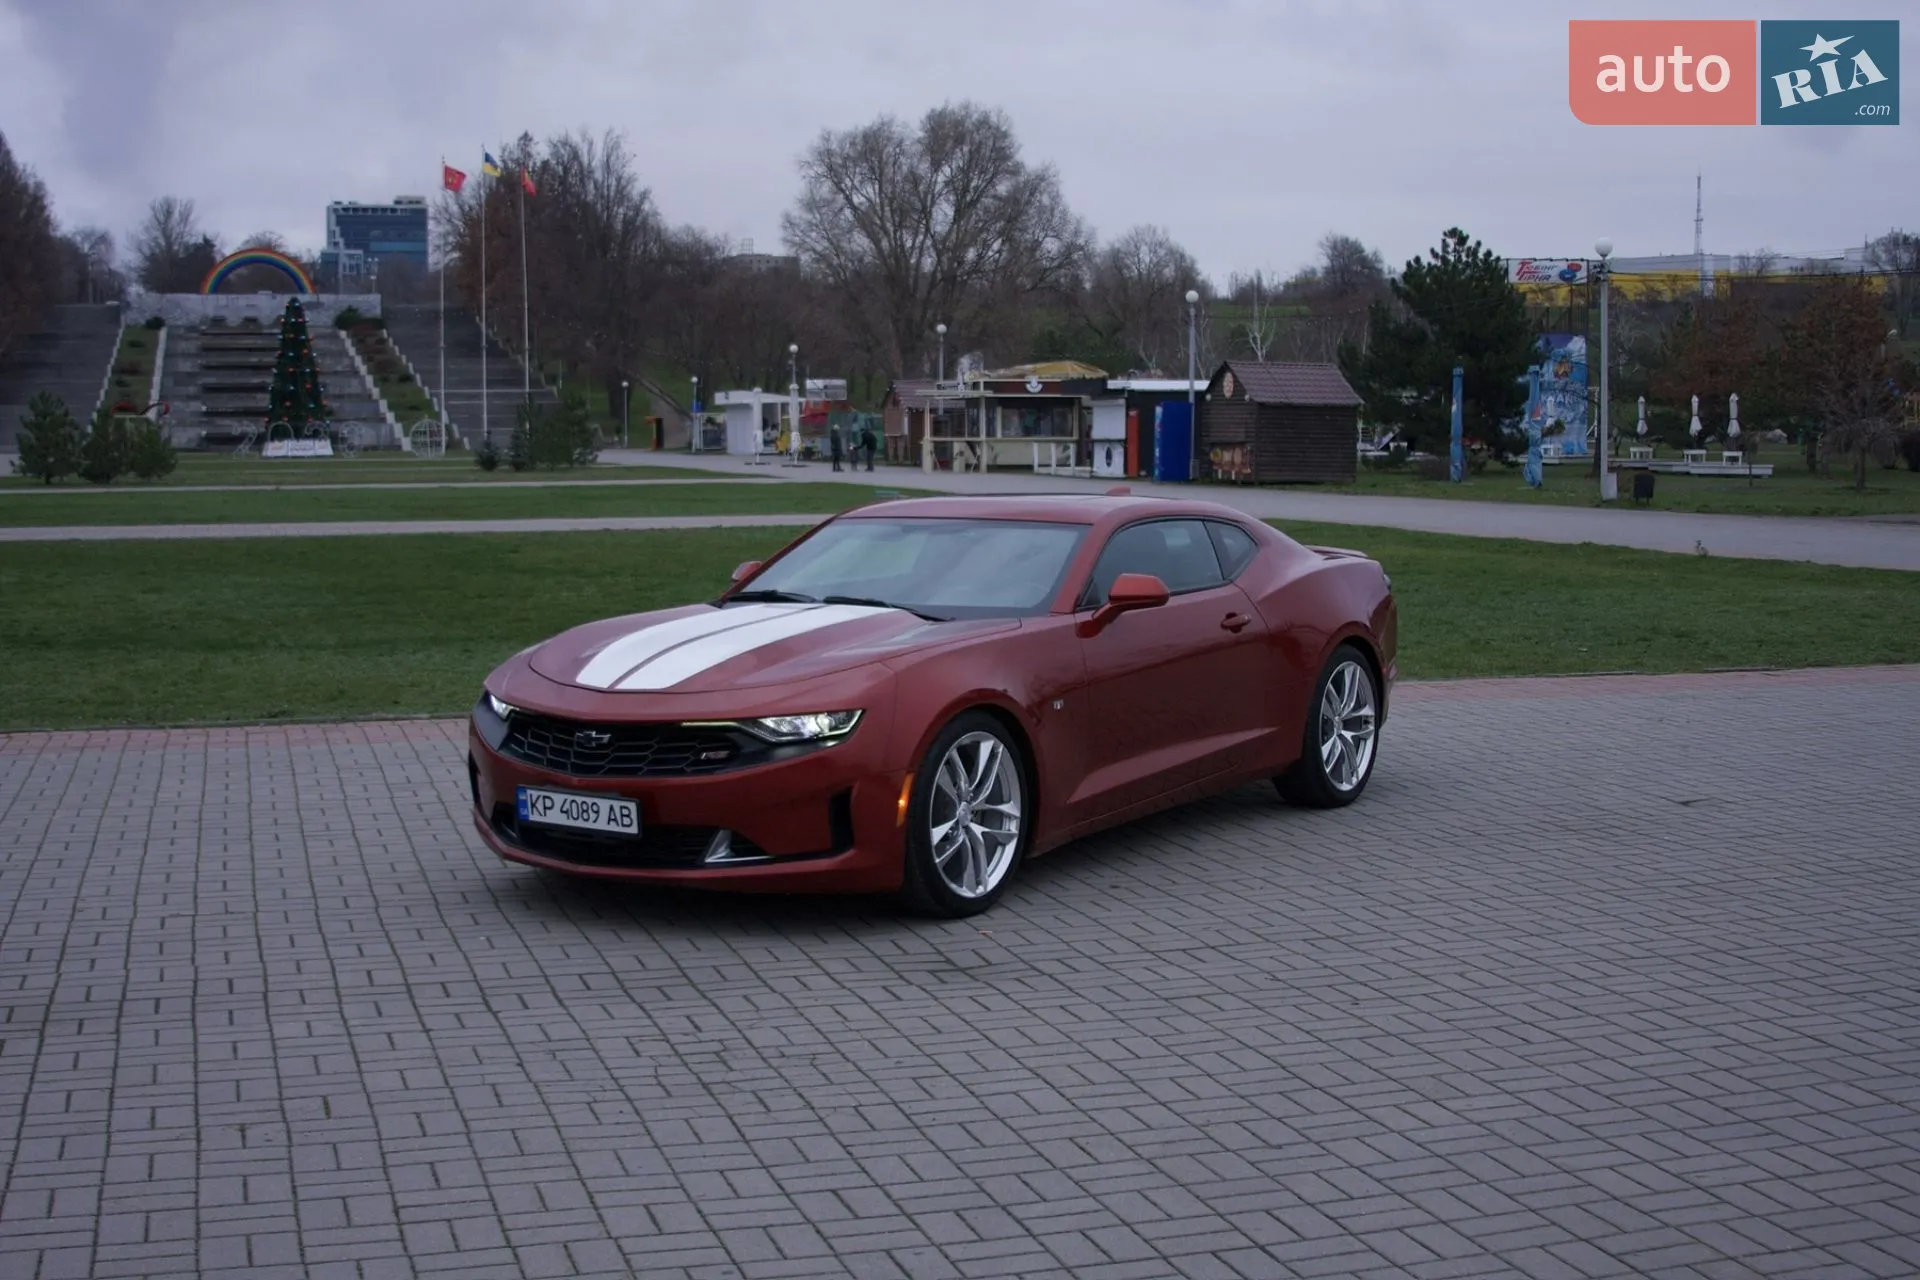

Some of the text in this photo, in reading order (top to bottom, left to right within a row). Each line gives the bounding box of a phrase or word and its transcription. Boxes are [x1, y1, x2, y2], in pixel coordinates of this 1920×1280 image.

[529, 793, 633, 828] KP 4089 AB
